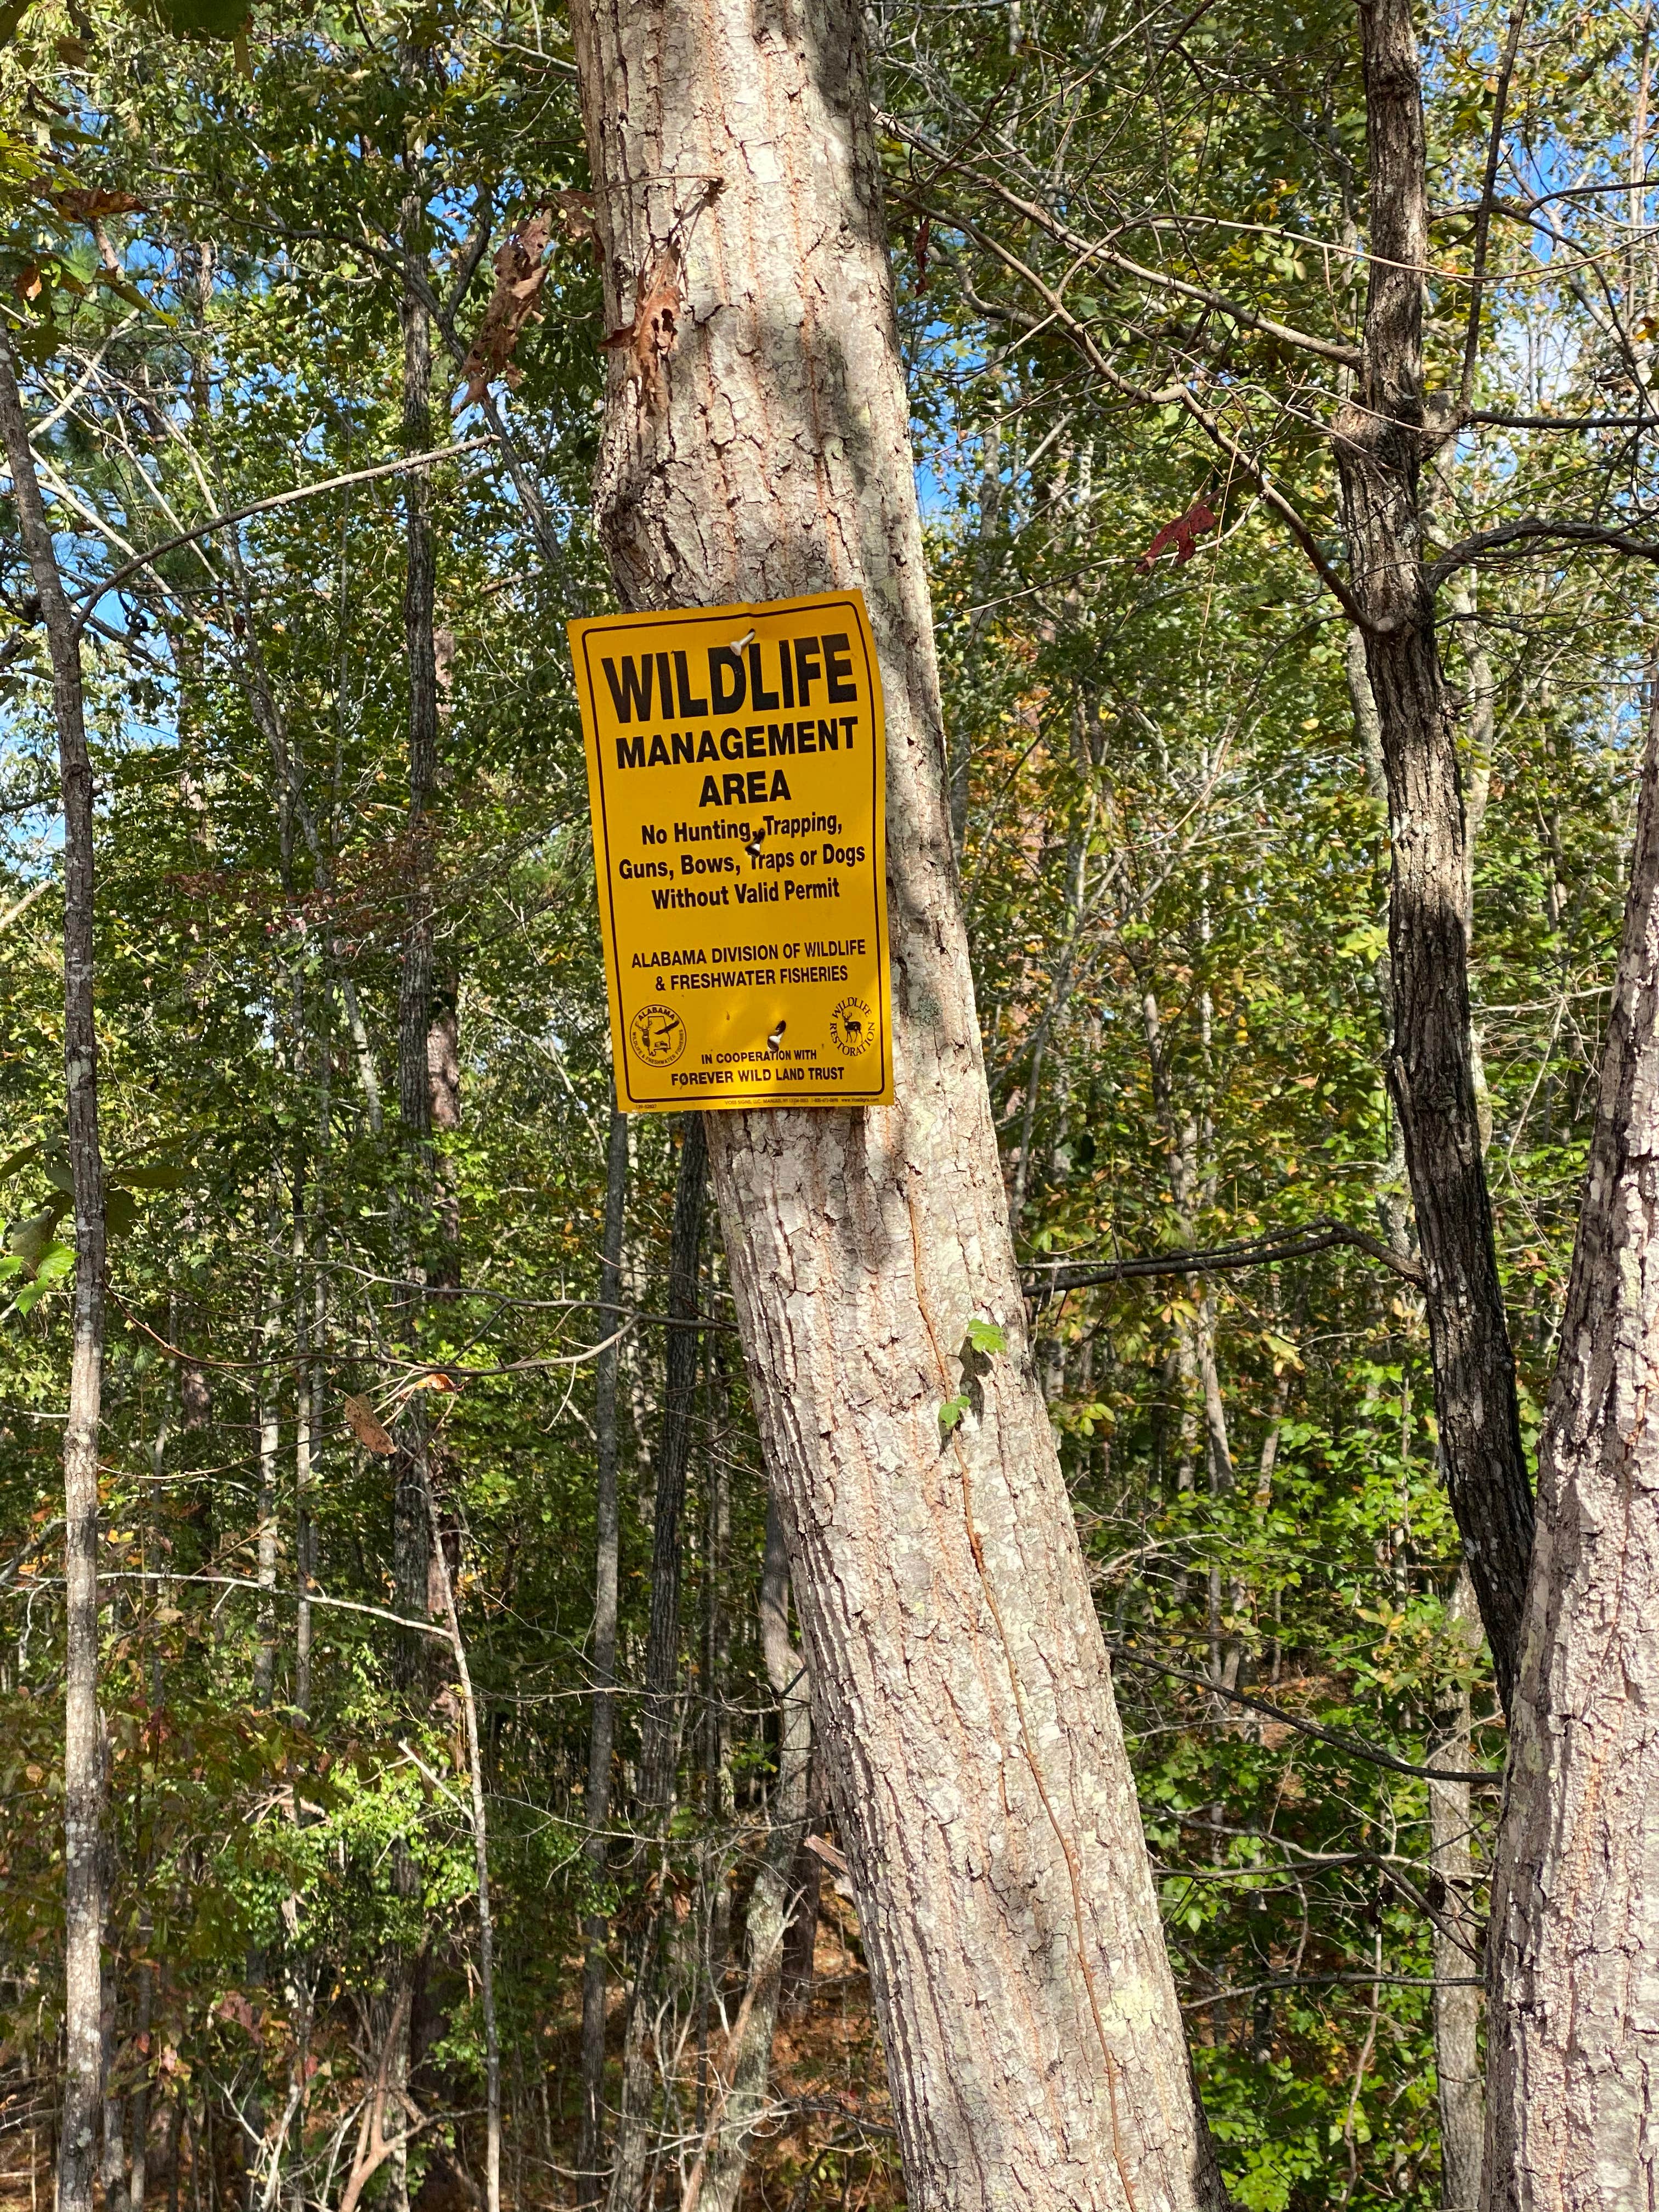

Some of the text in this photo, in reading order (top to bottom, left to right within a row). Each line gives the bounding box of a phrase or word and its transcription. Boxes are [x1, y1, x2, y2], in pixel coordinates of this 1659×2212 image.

[601, 633, 857, 723] WILDLIFE
[616, 716, 858, 769] MANAGEMENT
[699, 769, 792, 808] AREA
[642, 812, 842, 845] No Hunting, Trapping,
[619, 858, 674, 880] Guns,
[681, 854, 741, 876] Bows,
[800, 849, 817, 866] or
[823, 843, 865, 867] Dogs
[652, 877, 840, 910] Without Valid Permit
[631, 939, 866, 968] ALABAMA DIVISION OF WILDLIFE
[655, 965, 848, 991] & FRESHWATER FISHERIES
[638, 1007, 675, 1021] ALABAMA
[832, 997, 872, 1019] WILDLIFE
[830, 1022, 875, 1057] RESTORATION
[701, 1049, 817, 1064] IN COOPERATION WITH
[671, 1066, 844, 1086] FOREVER WILD LAND TRUST
